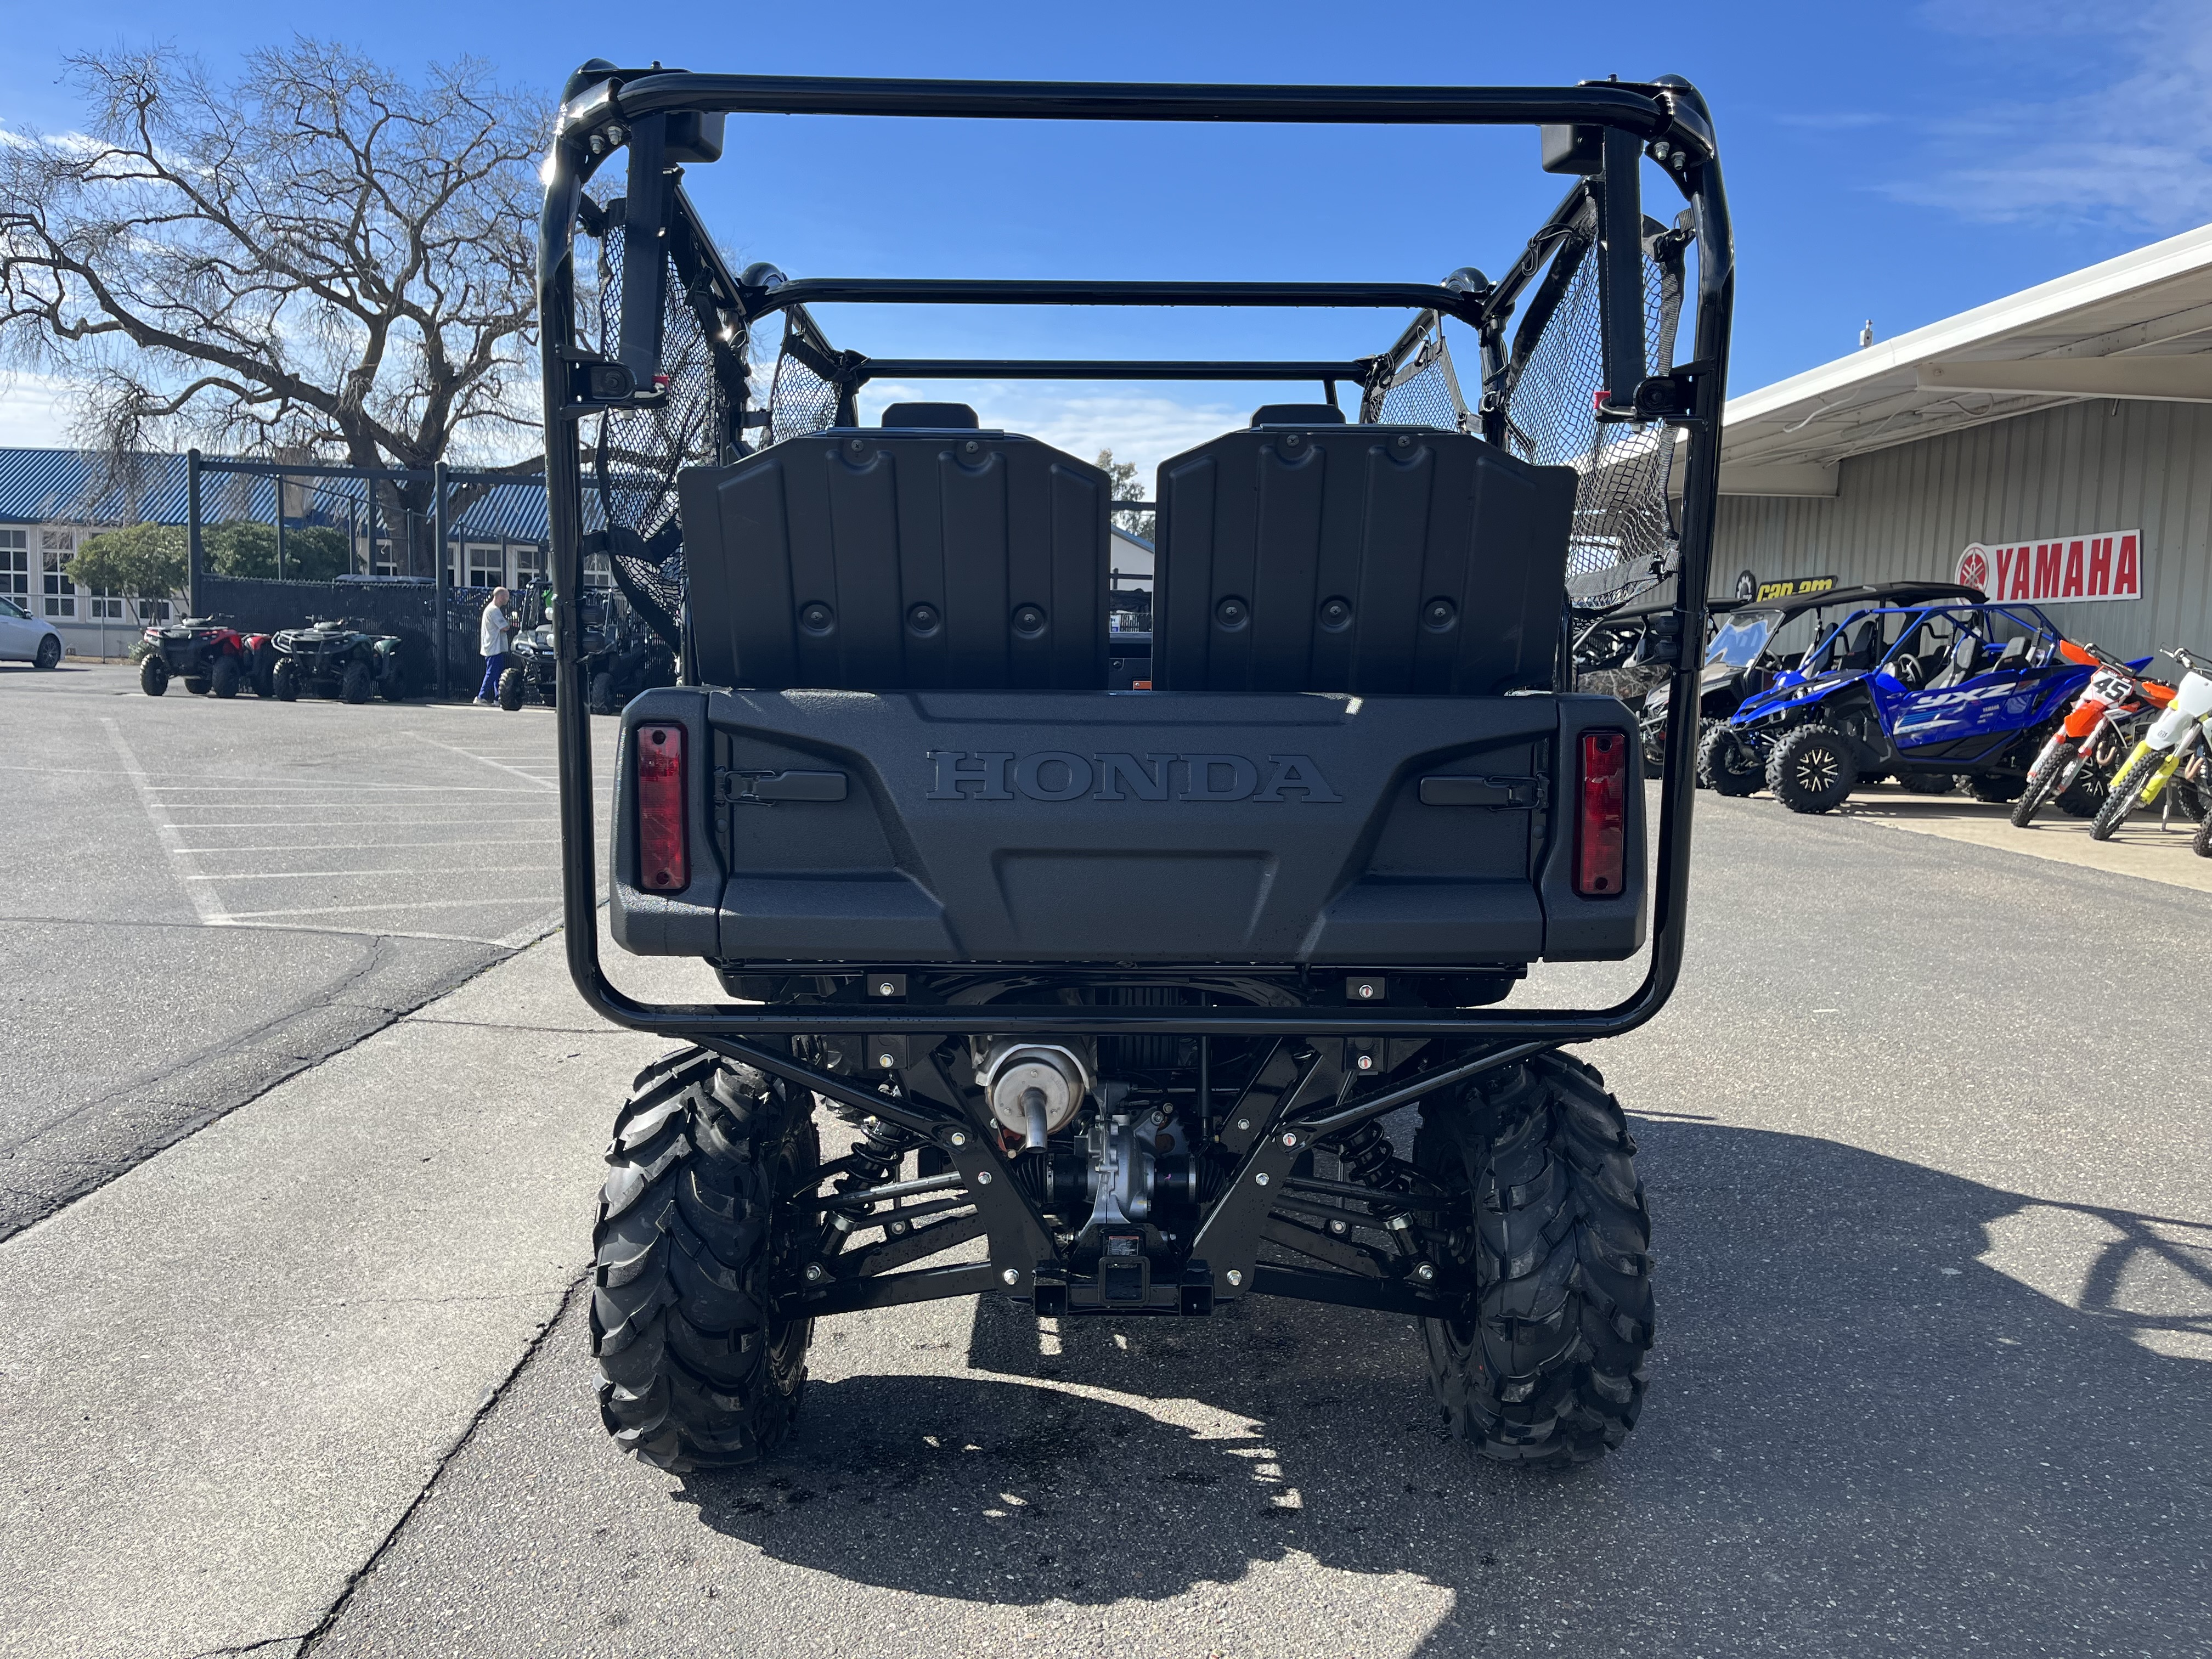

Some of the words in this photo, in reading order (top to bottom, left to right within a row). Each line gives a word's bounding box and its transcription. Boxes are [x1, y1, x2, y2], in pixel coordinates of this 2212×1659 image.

[1996, 535, 2137, 601] YAMAHA
[1911, 682, 2017, 710] YXZ
[2094, 677, 2130, 701] 45
[1982, 704, 2000, 713] YAMAHA
[926, 751, 1343, 803] HONDA
